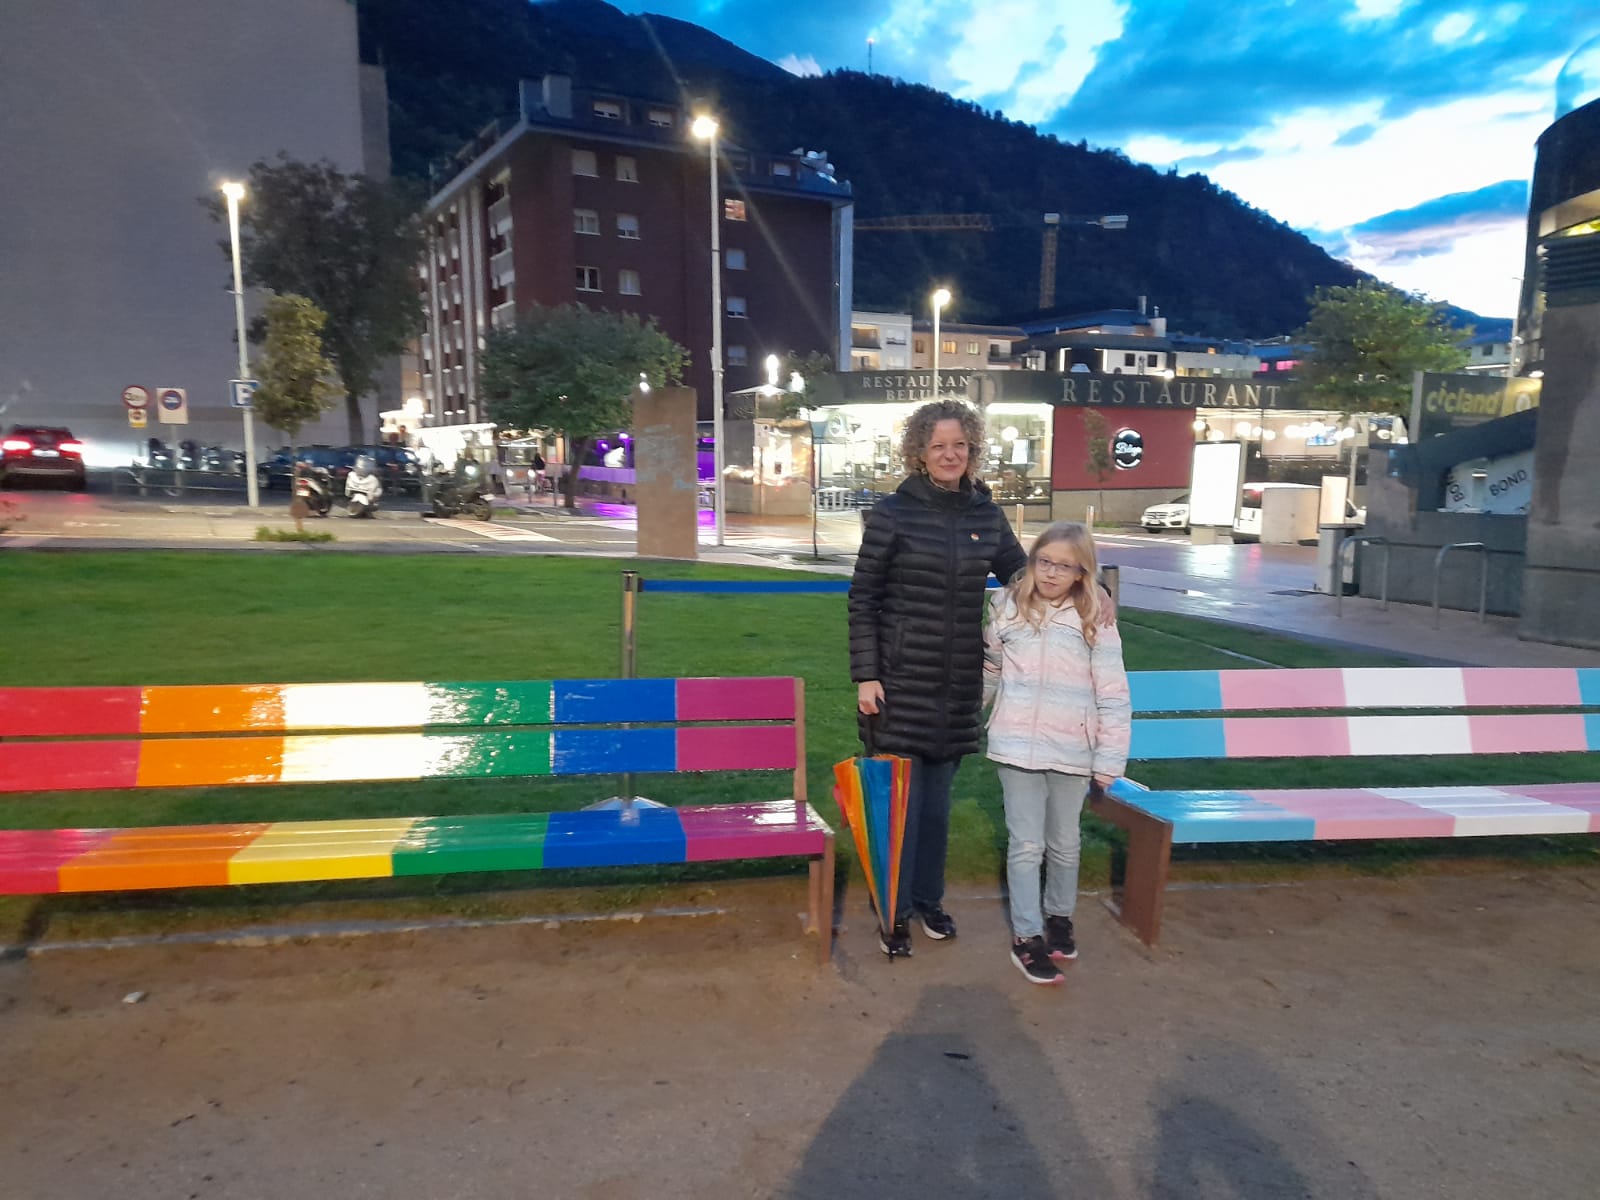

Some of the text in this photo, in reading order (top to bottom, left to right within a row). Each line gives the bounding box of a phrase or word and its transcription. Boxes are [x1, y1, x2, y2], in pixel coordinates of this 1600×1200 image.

[863, 375, 970, 388] RESTAURAN
[1062, 378, 1281, 407] RESTAURANT
[1489, 469, 1527, 496] BOND
